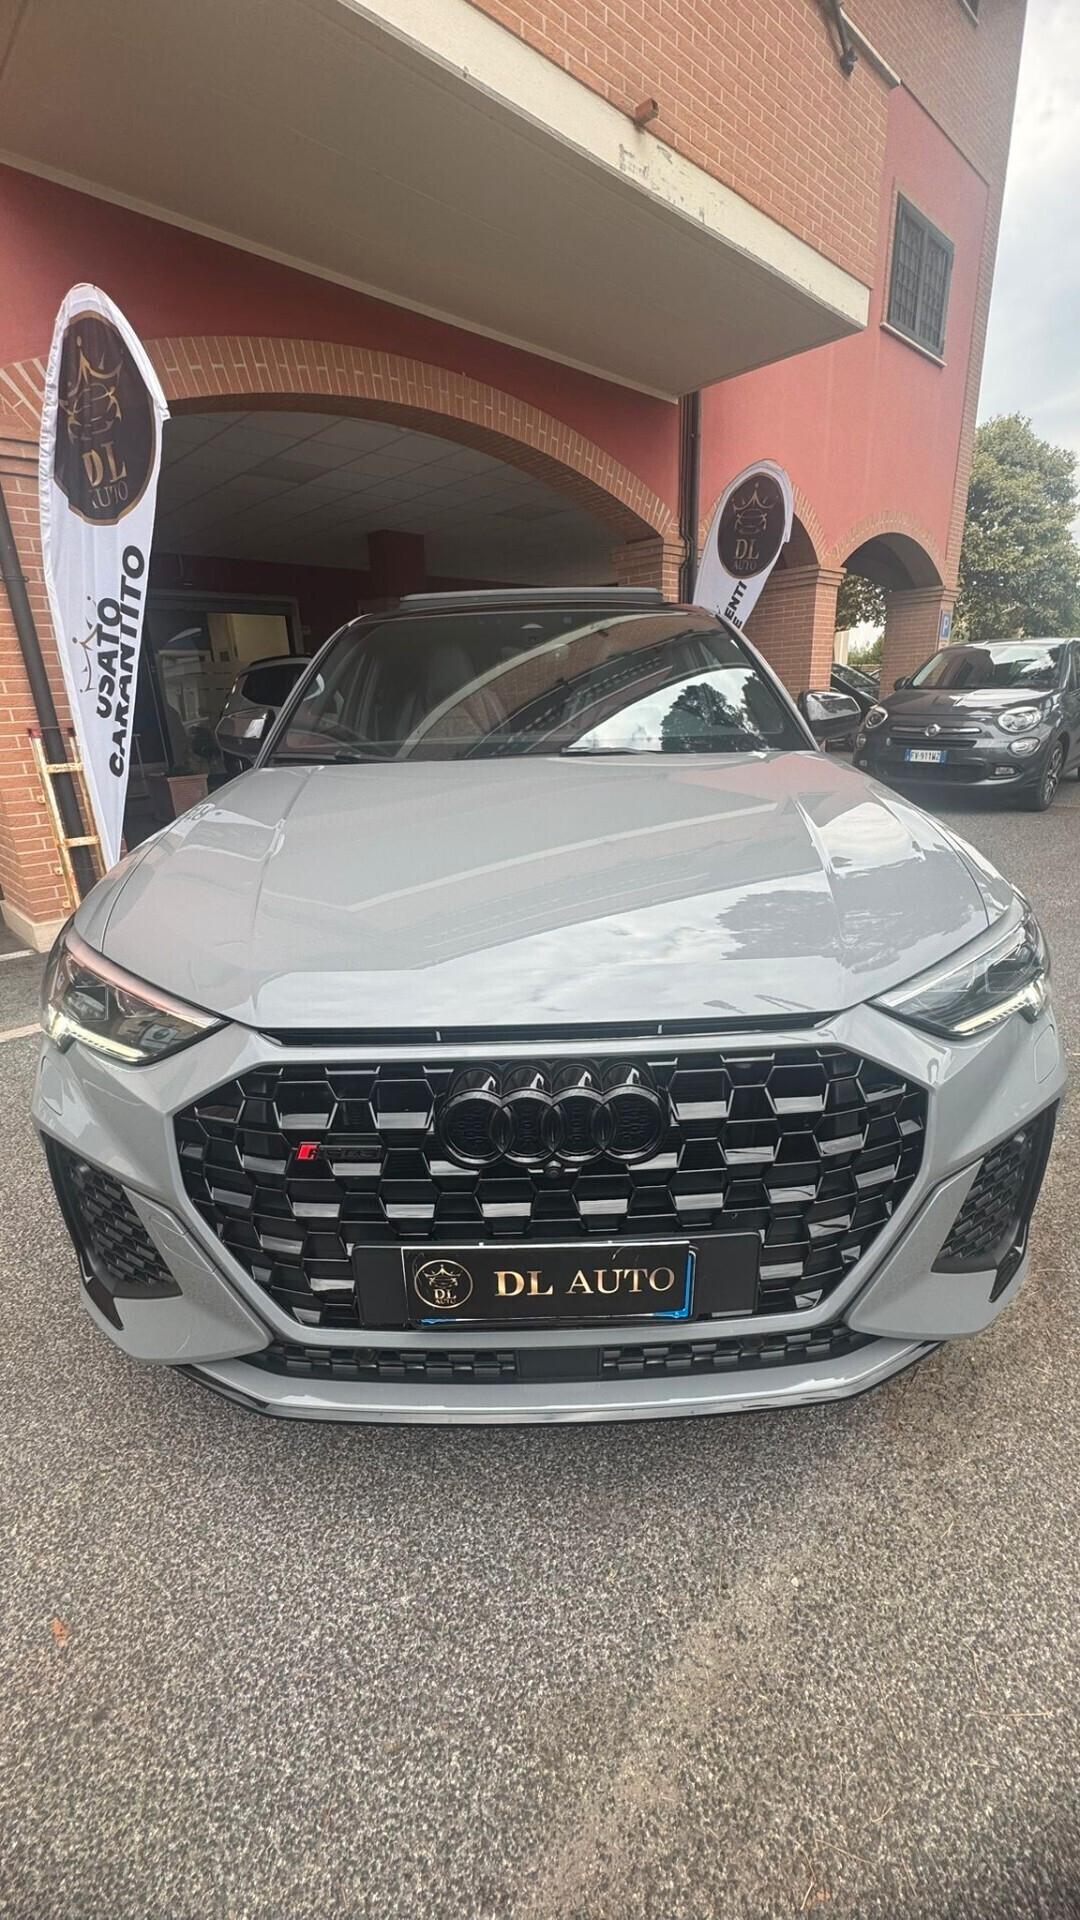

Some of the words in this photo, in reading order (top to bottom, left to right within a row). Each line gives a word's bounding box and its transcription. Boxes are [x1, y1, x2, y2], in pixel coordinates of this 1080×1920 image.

[82, 441, 127, 487] DL
[735, 539, 759, 559] DL
[97, 597, 121, 719] USATO
[434, 1289, 457, 1299] DL
[494, 1270, 554, 1297] DL
[565, 1266, 675, 1294] AUTO
